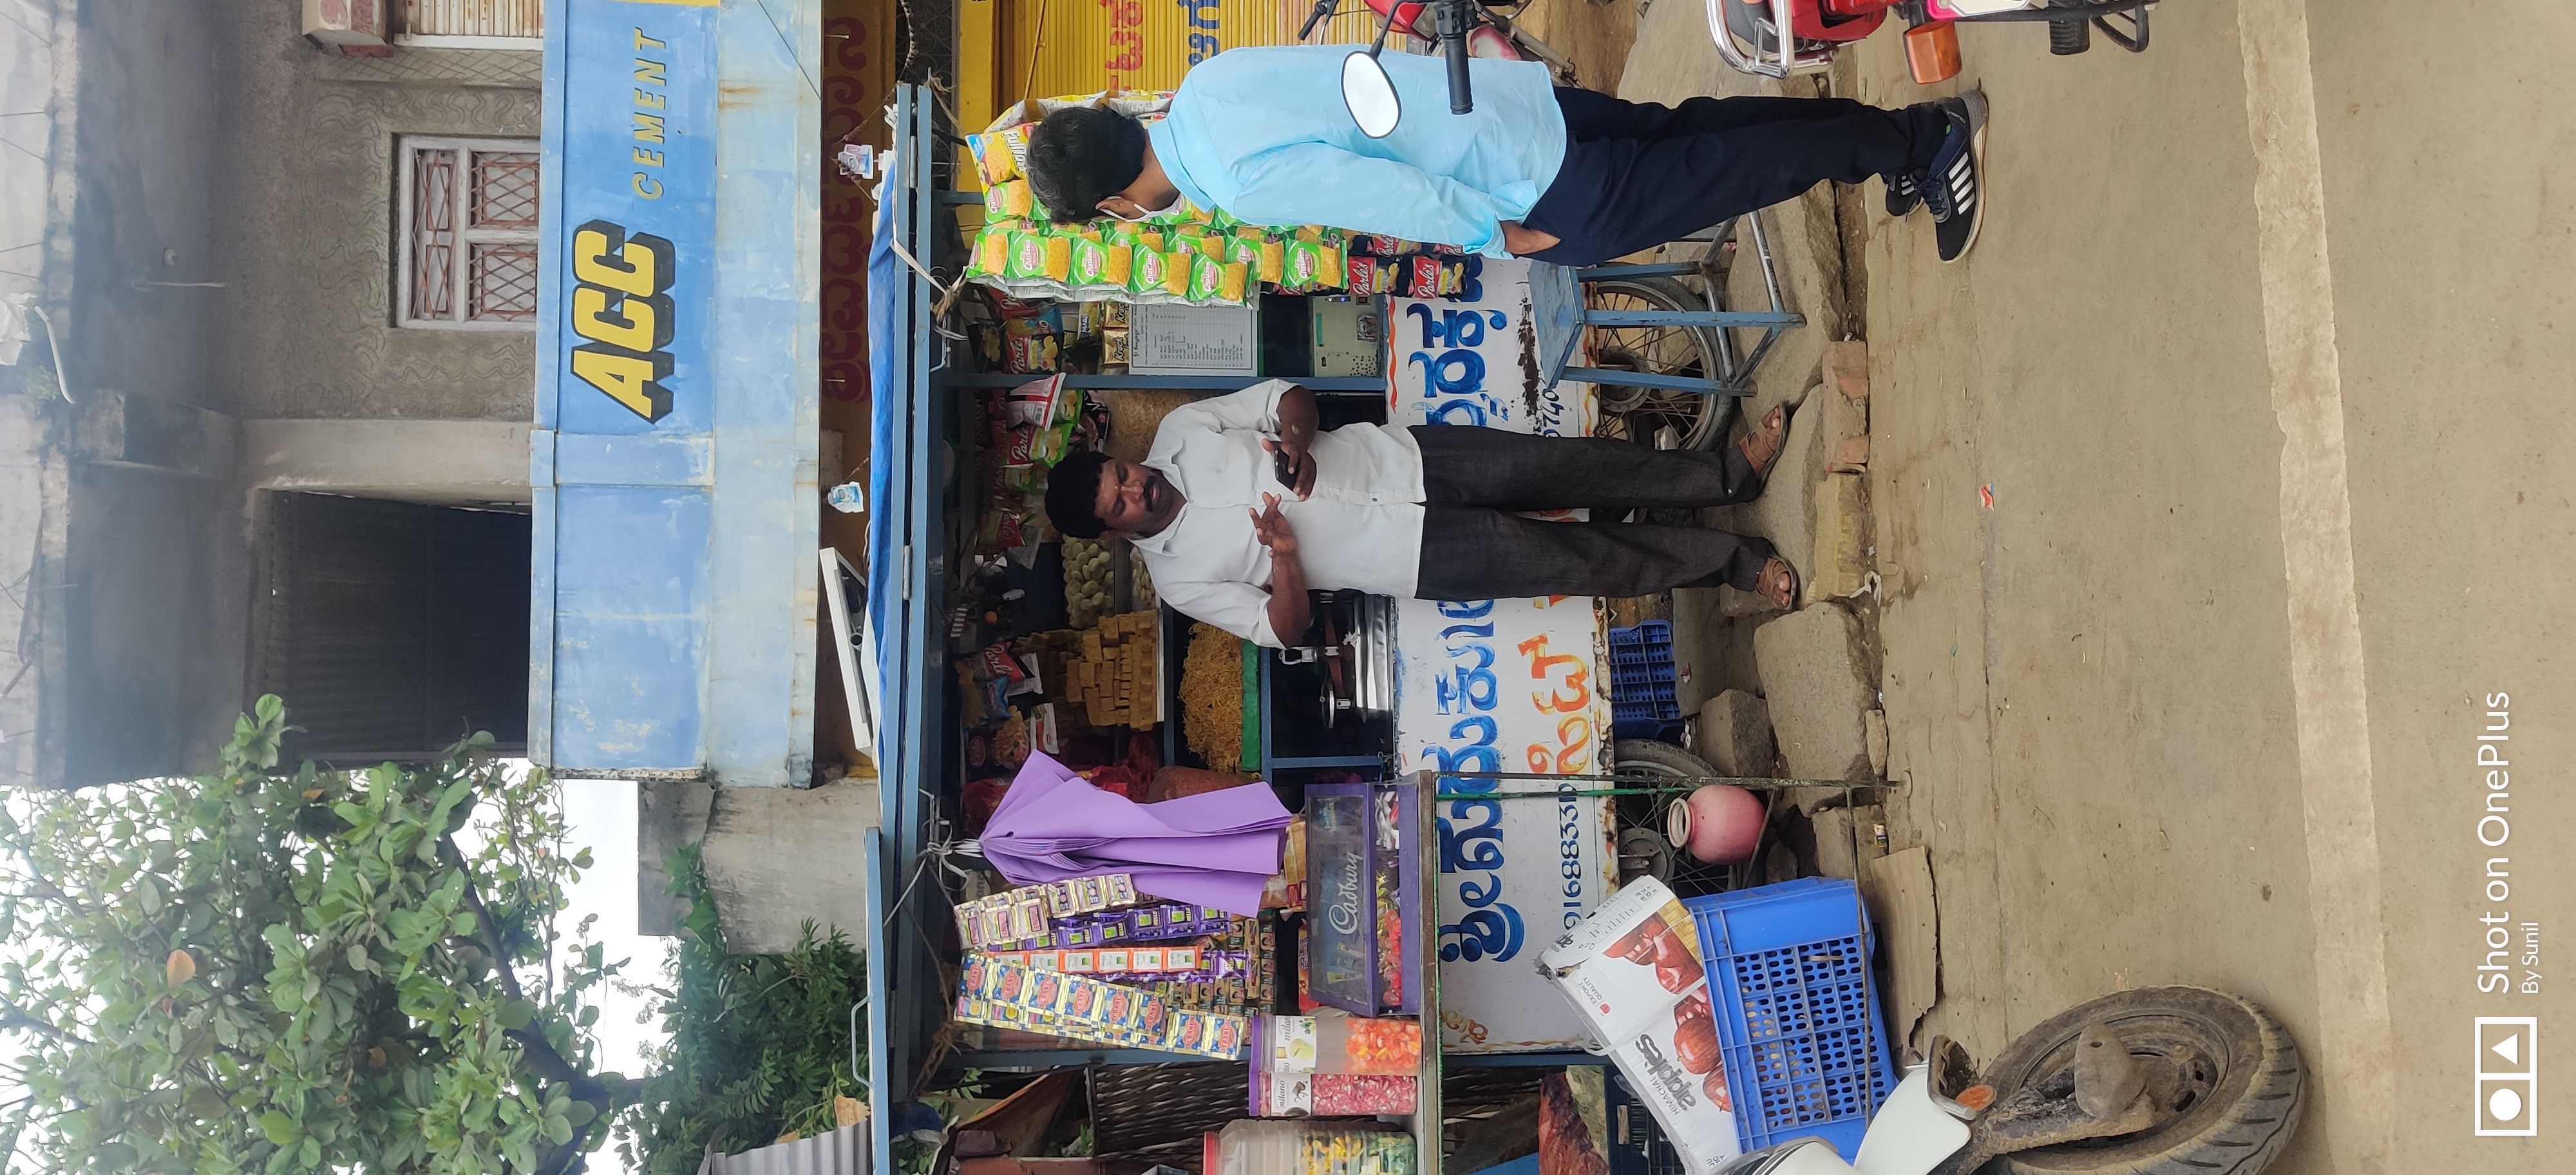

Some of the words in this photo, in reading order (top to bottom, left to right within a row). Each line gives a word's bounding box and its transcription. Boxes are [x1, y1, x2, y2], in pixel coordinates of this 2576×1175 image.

[631, 26, 667, 200] CEMENT
[1352, 262, 1371, 295] Parle's
[1417, 263, 1436, 298] Parle's
[571, 227, 657, 420] ACC
[1328, 851, 1364, 935] Cadbury
[1578, 981, 1598, 1004] EXPORT
[1582, 976, 1602, 1000] QUALITY
[1281, 1017, 1291, 1041] milan
[1635, 1033, 1696, 1111] apples
[1277, 1080, 1286, 1108] milano
[1650, 1076, 1680, 1116] HIMACHAL
